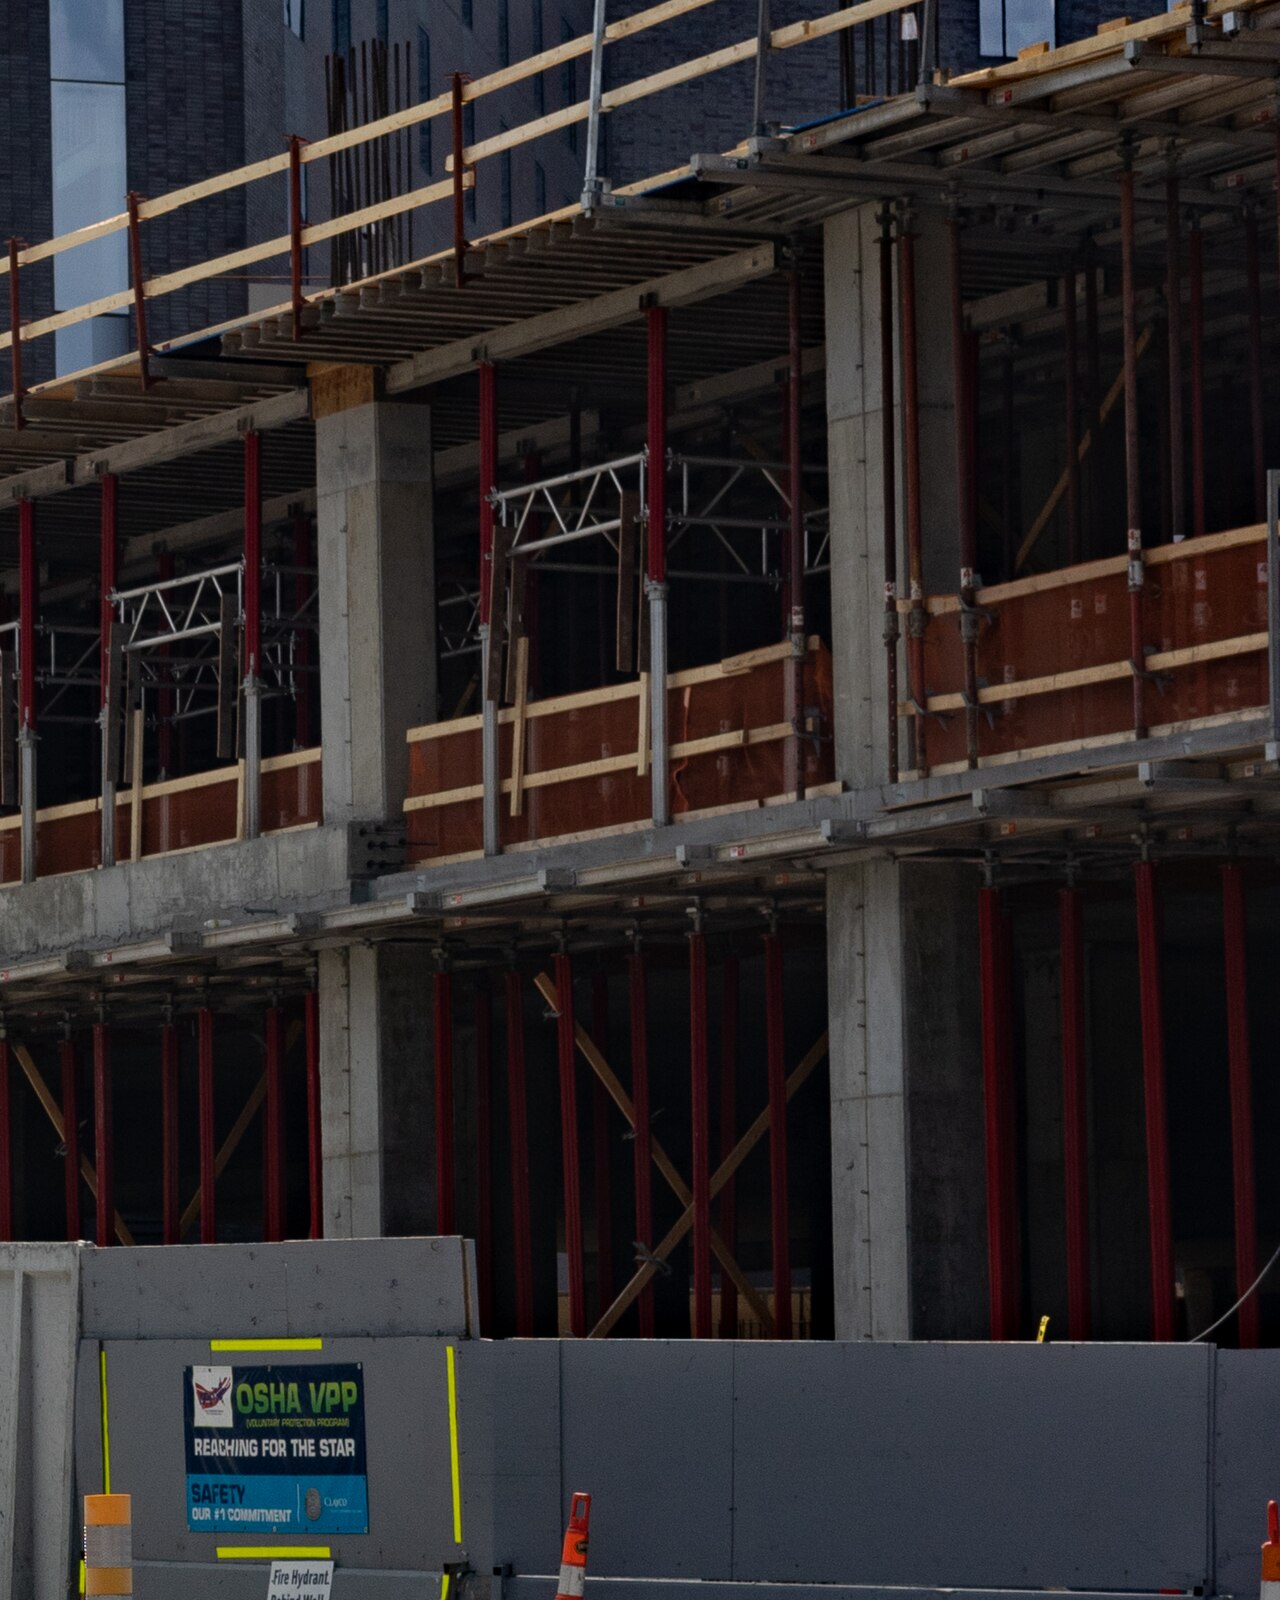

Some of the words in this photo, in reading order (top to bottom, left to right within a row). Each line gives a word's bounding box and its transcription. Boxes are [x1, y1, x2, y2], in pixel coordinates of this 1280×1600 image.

[236, 1382, 302, 1414] OSHA
[308, 1381, 358, 1414] VPP
[281, 1418, 316, 1427] PROTECTION
[194, 1438, 258, 1457] REACHING
[262, 1438, 287, 1457] FOR
[291, 1438, 316, 1457] THE
[319, 1438, 355, 1457] STAR
[191, 1483, 246, 1505] SAFETY
[192, 1508, 211, 1521] OUR
[214, 1508, 226, 1521] #1
[228, 1508, 292, 1523] COMMITMENT
[273, 1569, 290, 1585] Fire
[291, 1569, 328, 1589] Hydrant
